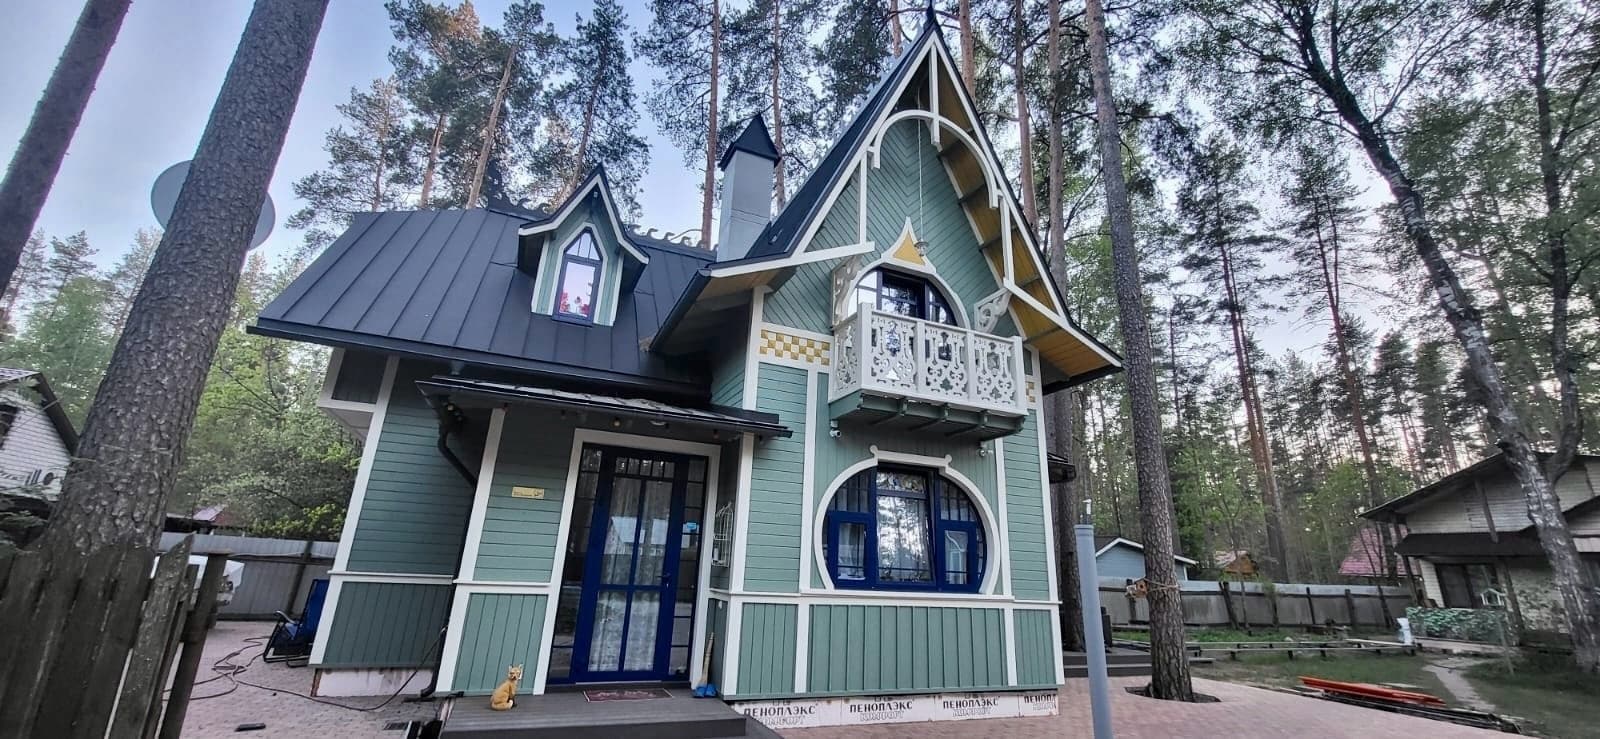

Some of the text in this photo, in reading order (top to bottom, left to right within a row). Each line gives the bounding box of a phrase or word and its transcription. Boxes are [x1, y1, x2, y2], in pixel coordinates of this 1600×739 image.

[850, 701, 913, 713] ПЕНОПЛЭКС
[943, 698, 999, 709] ПЕНОПЛЭКС
[744, 705, 816, 717] ПЕНОПЛЭКС
